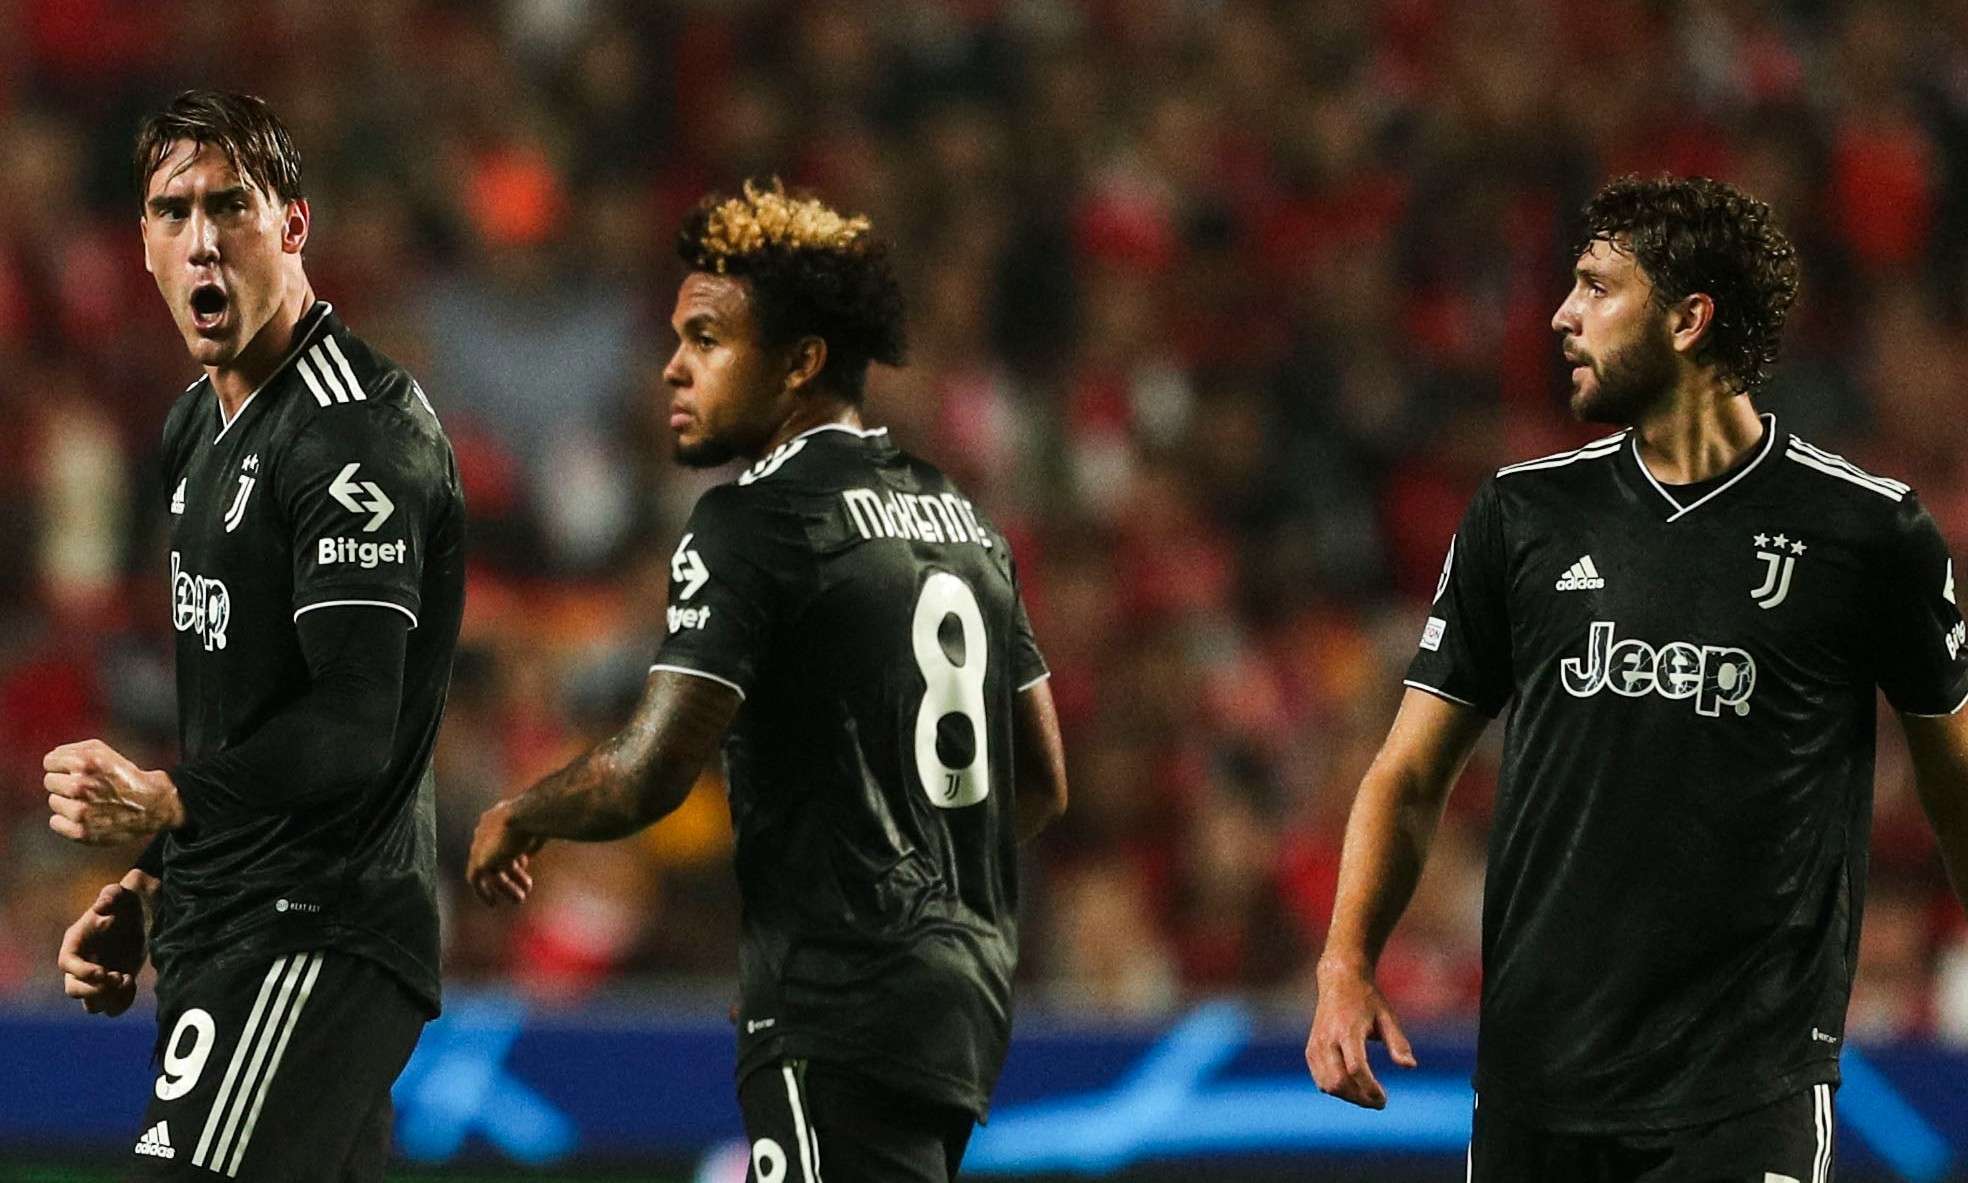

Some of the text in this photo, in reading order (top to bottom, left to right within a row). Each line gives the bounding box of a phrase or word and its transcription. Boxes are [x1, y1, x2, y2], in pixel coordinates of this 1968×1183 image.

[842, 488, 993, 548] McKENN
[318, 537, 406, 569] Bitget
[1555, 576, 1605, 591] adidas
[912, 571, 989, 809] 8
[1560, 621, 1757, 717] Jeep
[155, 1007, 216, 1101] 9
[134, 1142, 176, 1159] adidas
